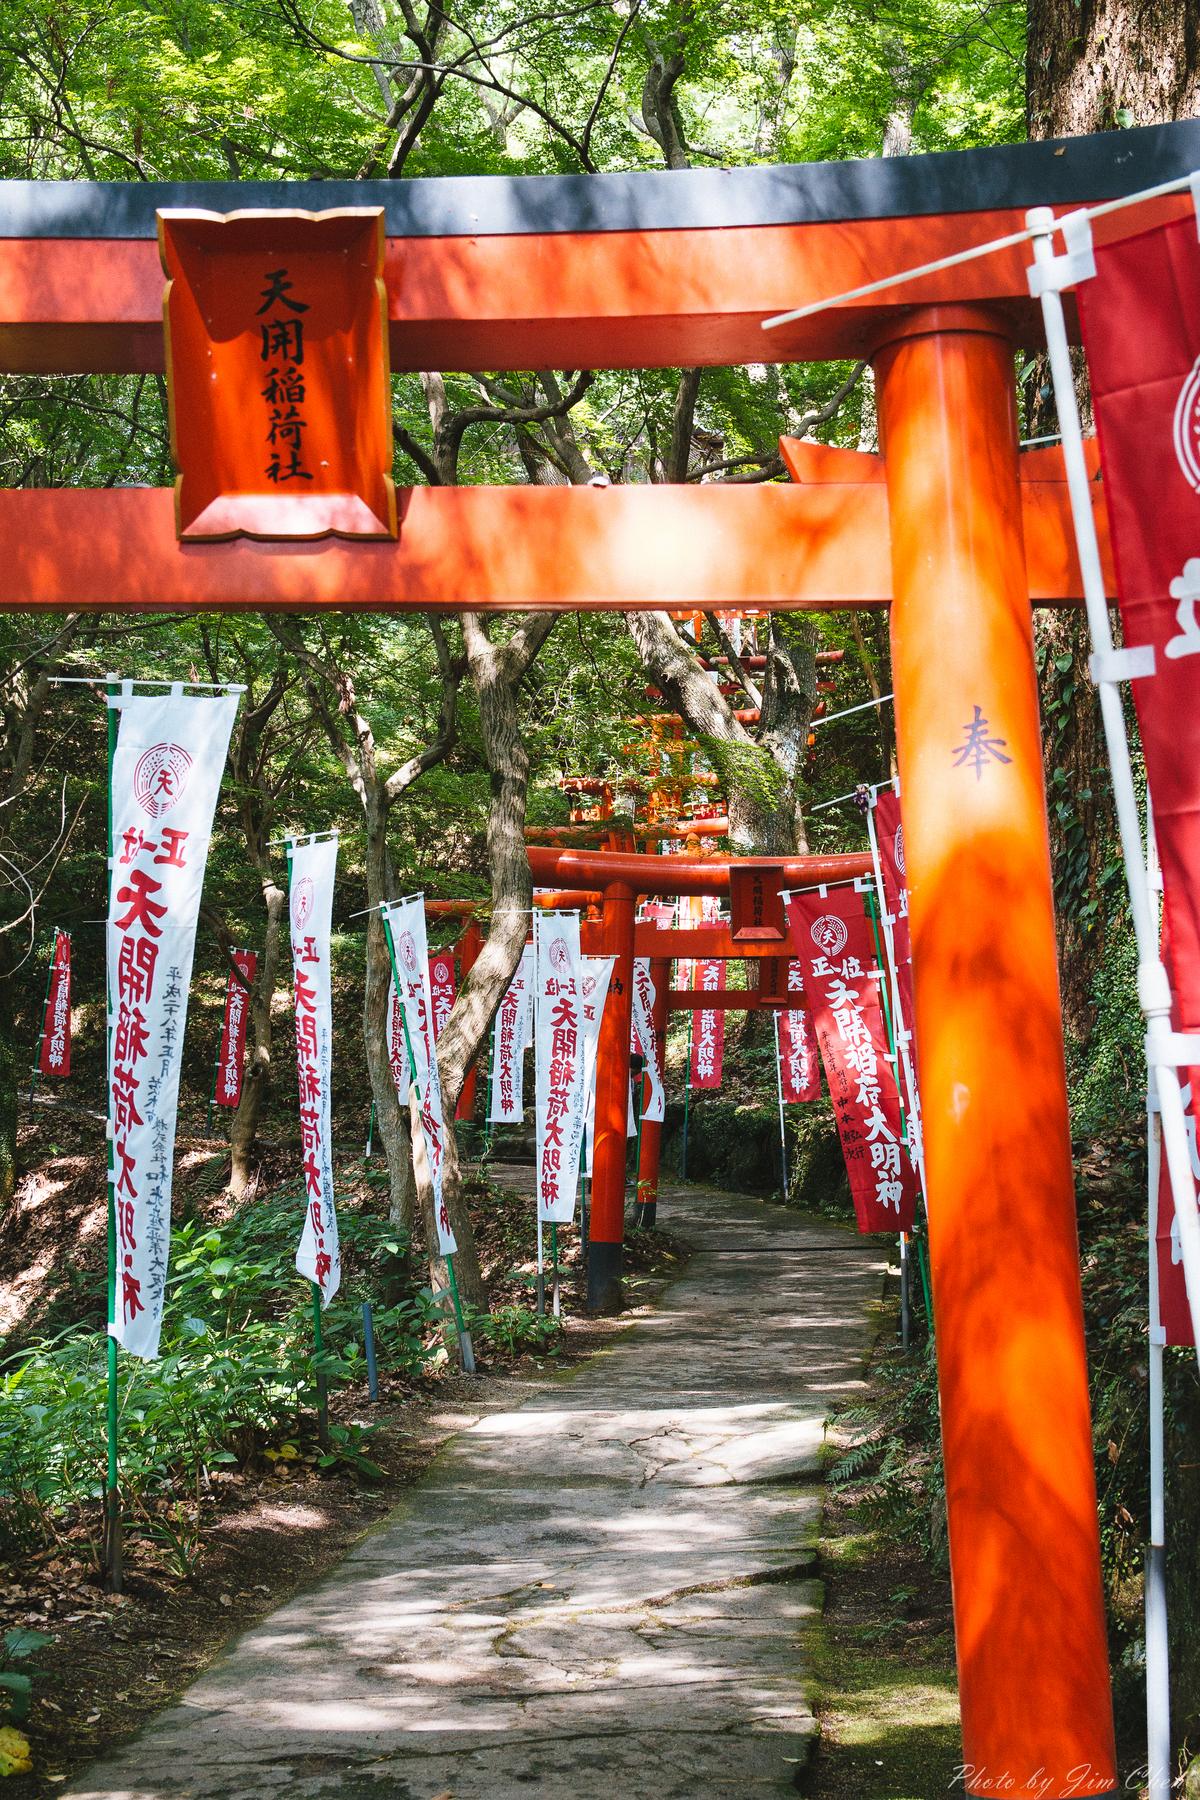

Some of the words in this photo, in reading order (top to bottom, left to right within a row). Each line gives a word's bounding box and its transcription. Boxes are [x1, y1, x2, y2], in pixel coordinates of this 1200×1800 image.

[256, 268, 313, 483] 天開稲荷社
[951, 704, 1013, 782] 奉
[810, 956, 865, 980] 正一位
[822, 929, 838, 945] 天
[825, 979, 903, 1214] 天開稲荷大明神
